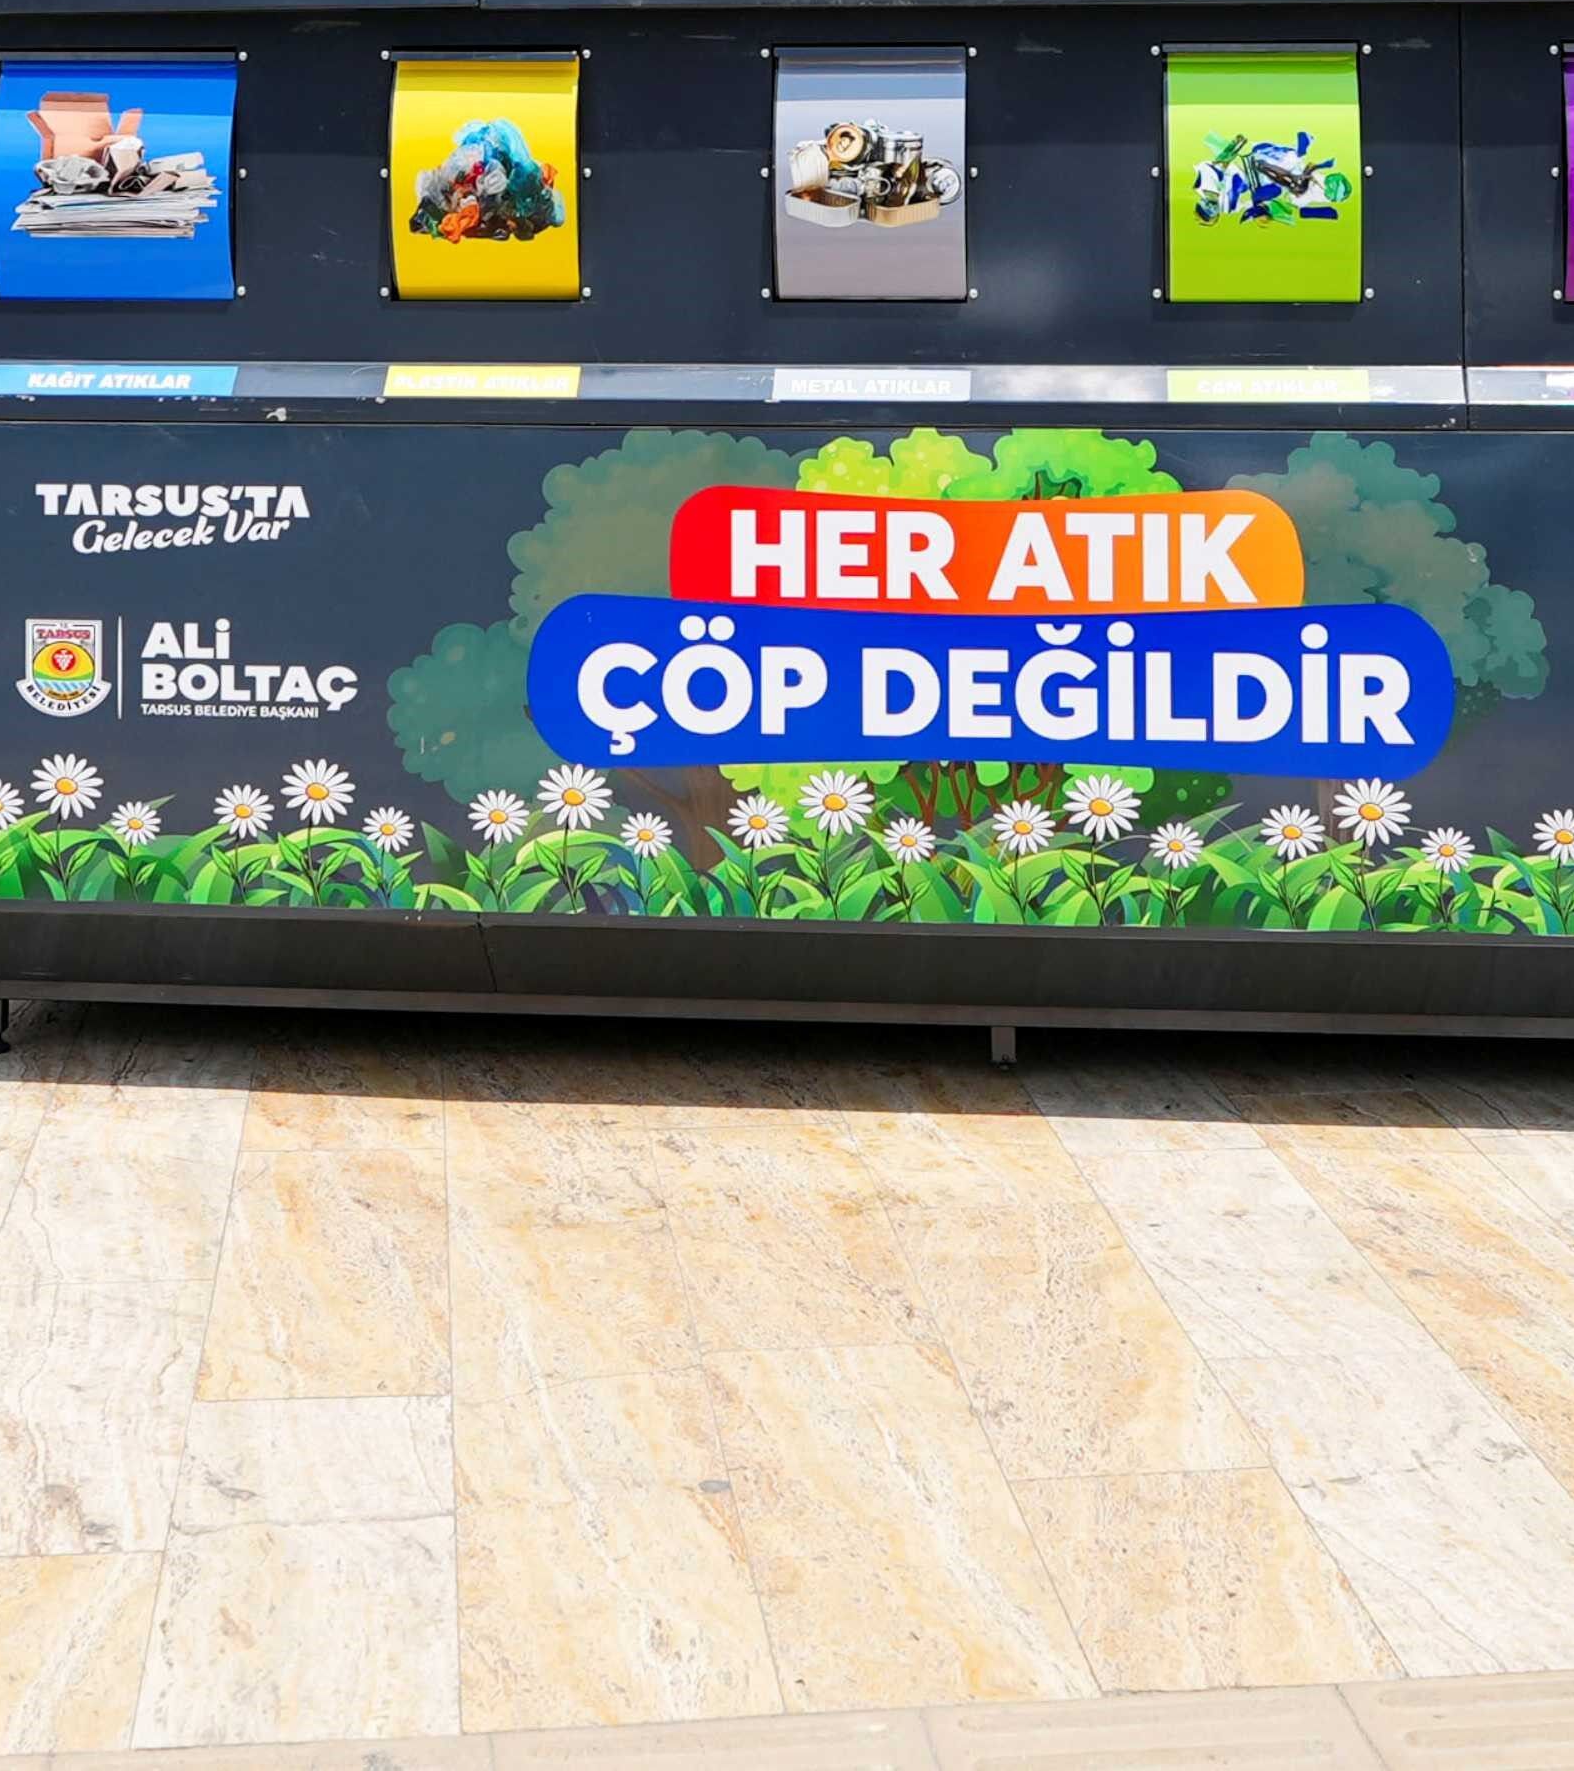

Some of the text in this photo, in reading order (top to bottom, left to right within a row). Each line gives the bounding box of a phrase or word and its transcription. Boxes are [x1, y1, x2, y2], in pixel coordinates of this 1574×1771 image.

[28, 370, 193, 389] KAĞIT ATIKLAR
[791, 378, 951, 395] METAL ATIKLAR
[35, 483, 310, 519] TARSUS'TA
[72, 509, 291, 555] Gelecek Var
[729, 509, 1259, 604] HER ATIK
[36, 628, 91, 640] TARSUS
[140, 618, 231, 660] ALİ
[141, 663, 358, 711] BOLTAÇ
[576, 615, 1417, 756] ÇÖP DEĞİLDİR
[140, 703, 319, 721] TARSUS BELEDİYE BAŞKANI
